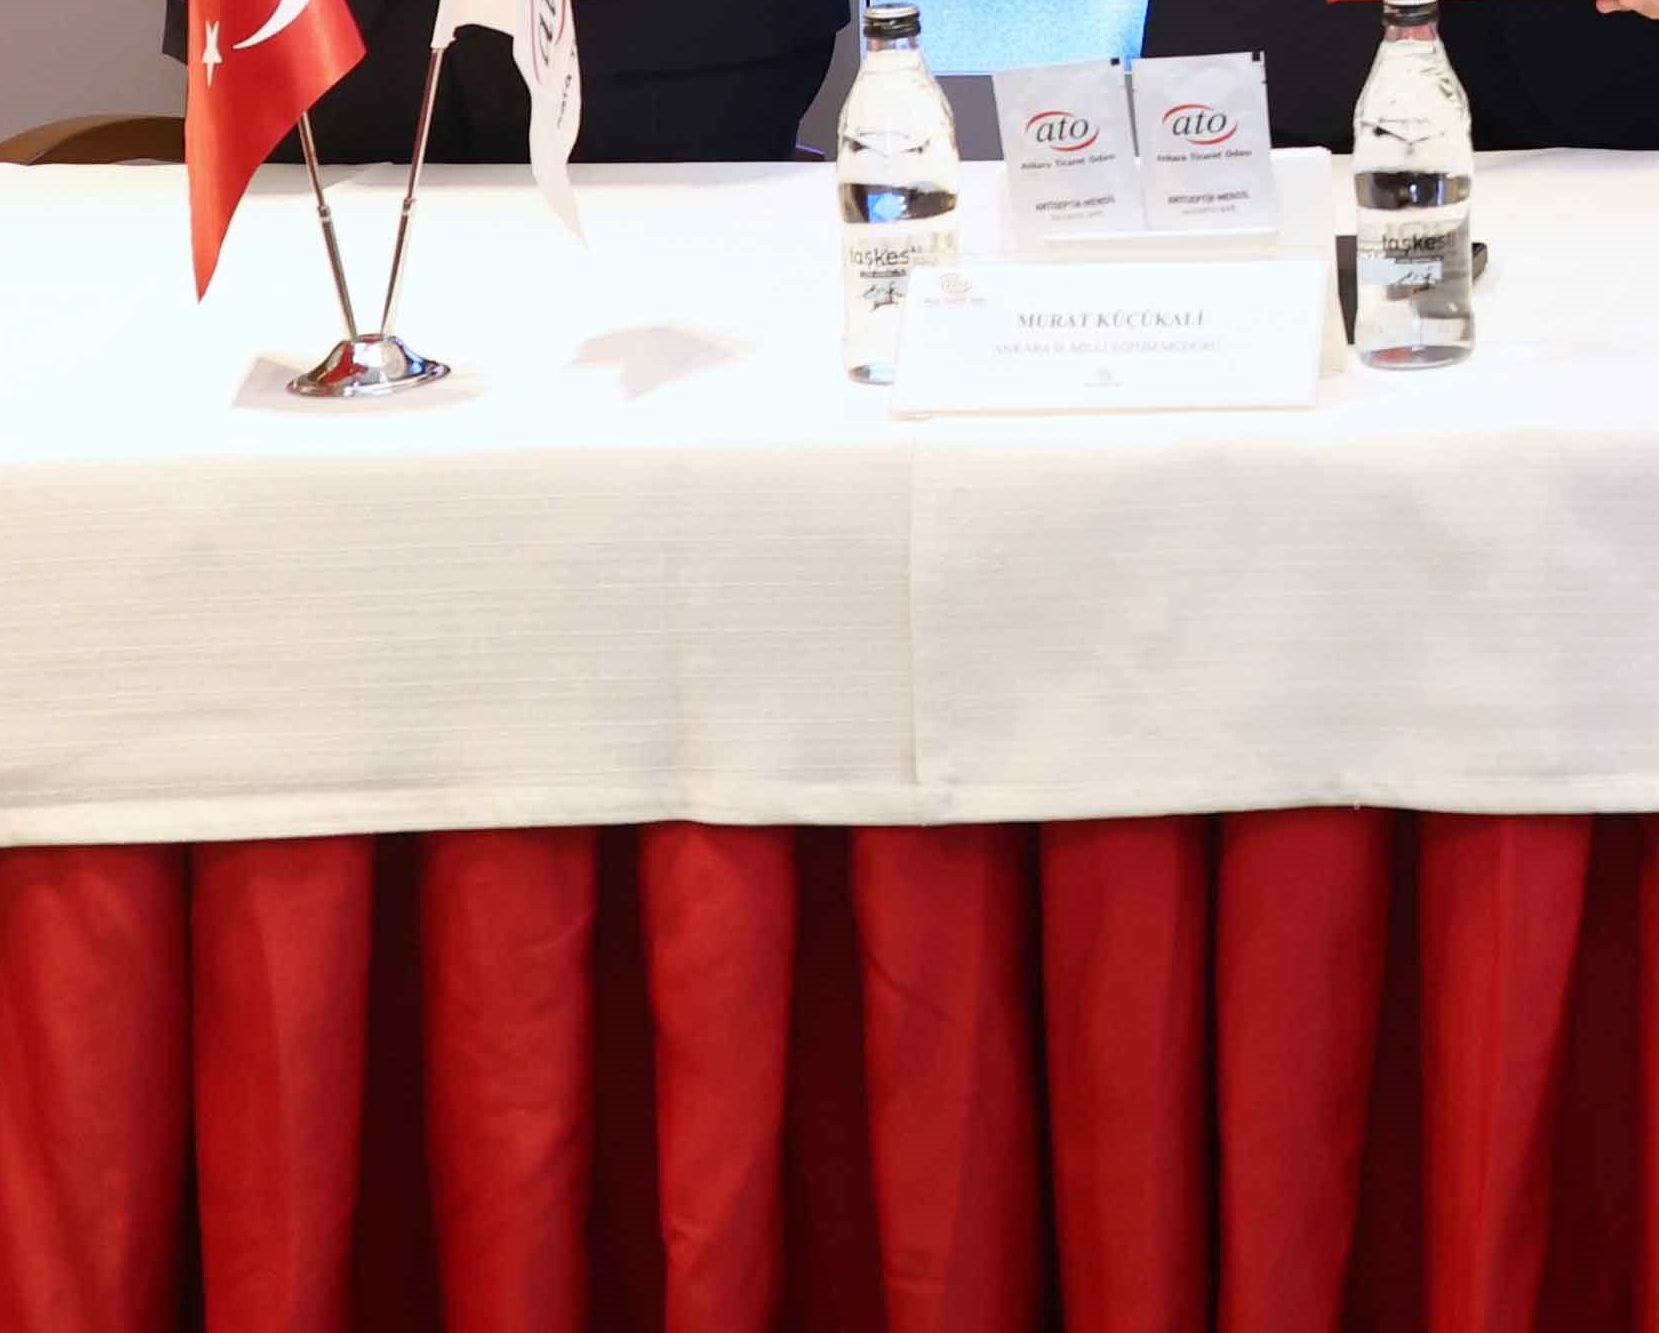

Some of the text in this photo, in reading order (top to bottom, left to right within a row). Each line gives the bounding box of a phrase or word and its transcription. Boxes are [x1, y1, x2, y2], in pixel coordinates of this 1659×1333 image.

[1036, 115, 1090, 144] ato
[1171, 107, 1227, 136] ato
[1016, 307, 1093, 330] MURAT
